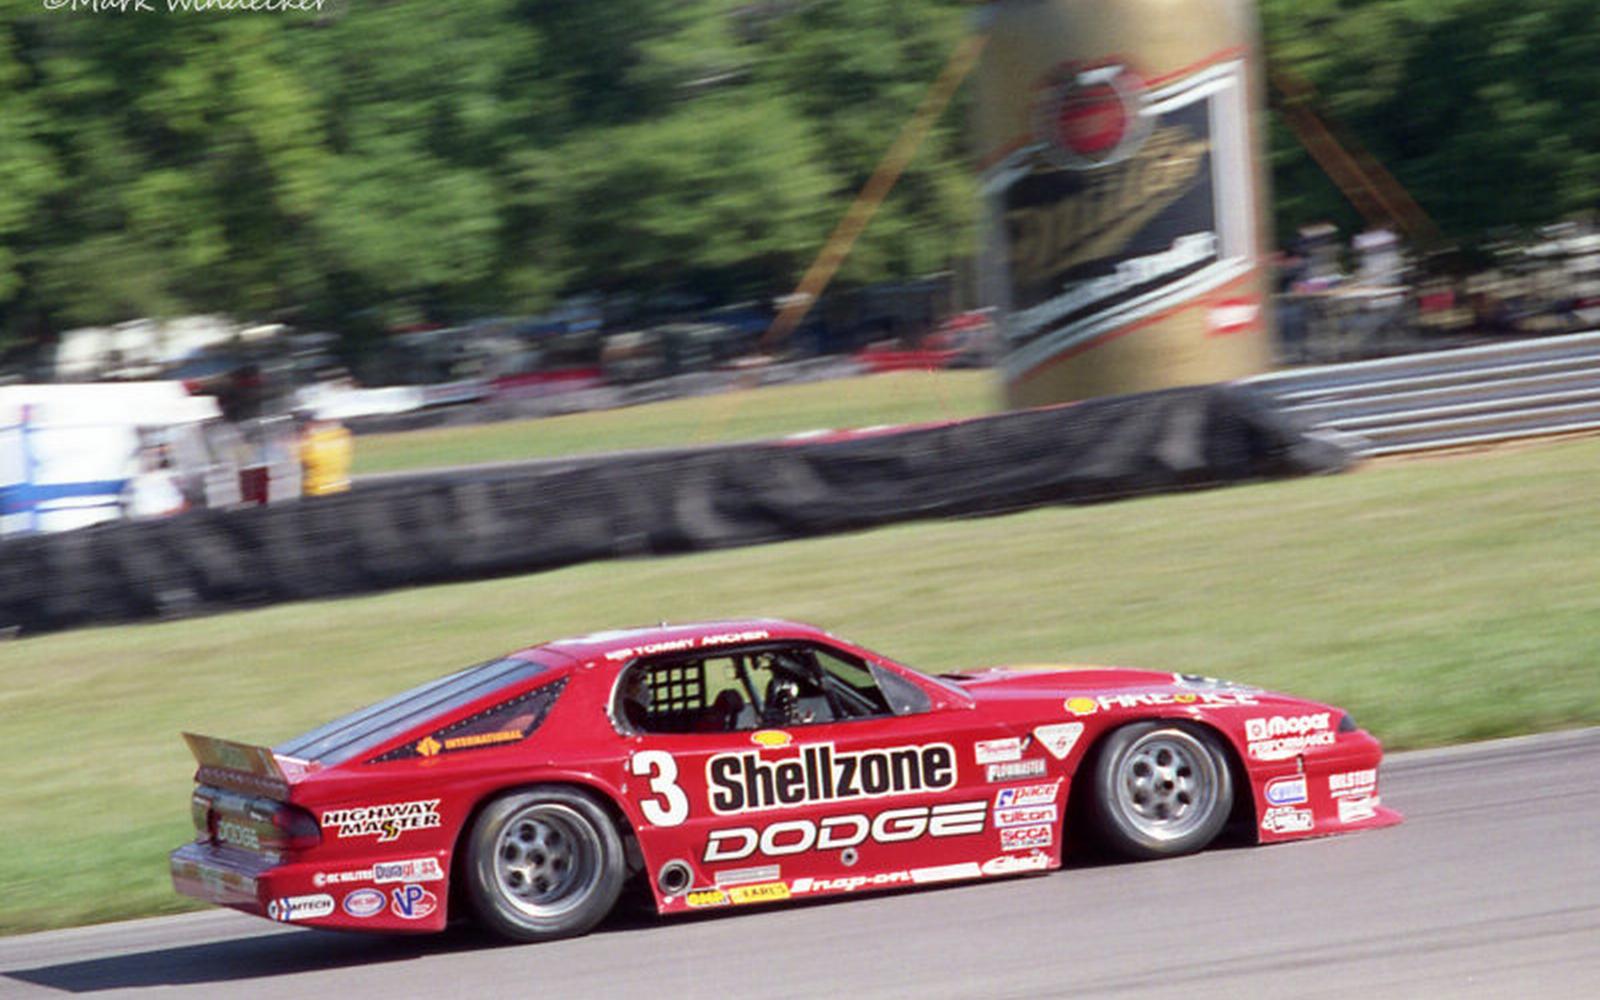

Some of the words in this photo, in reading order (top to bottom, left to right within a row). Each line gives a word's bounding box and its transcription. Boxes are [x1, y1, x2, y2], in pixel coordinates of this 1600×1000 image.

[634, 638, 694, 655] TOMMY
[1267, 712, 1331, 735] Mopar
[444, 730, 524, 749] INTERNATIONAL
[1248, 731, 1336, 756] PERFORMANCE
[632, 750, 689, 827] 3
[704, 742, 957, 816] Shellzone
[322, 799, 440, 827] HIGHWAY
[338, 814, 440, 842] MASTER
[704, 801, 989, 864] DODGE
[1002, 826, 1049, 841] SCCA
[790, 870, 911, 893] Snap-on
[394, 886, 423, 916] VP
